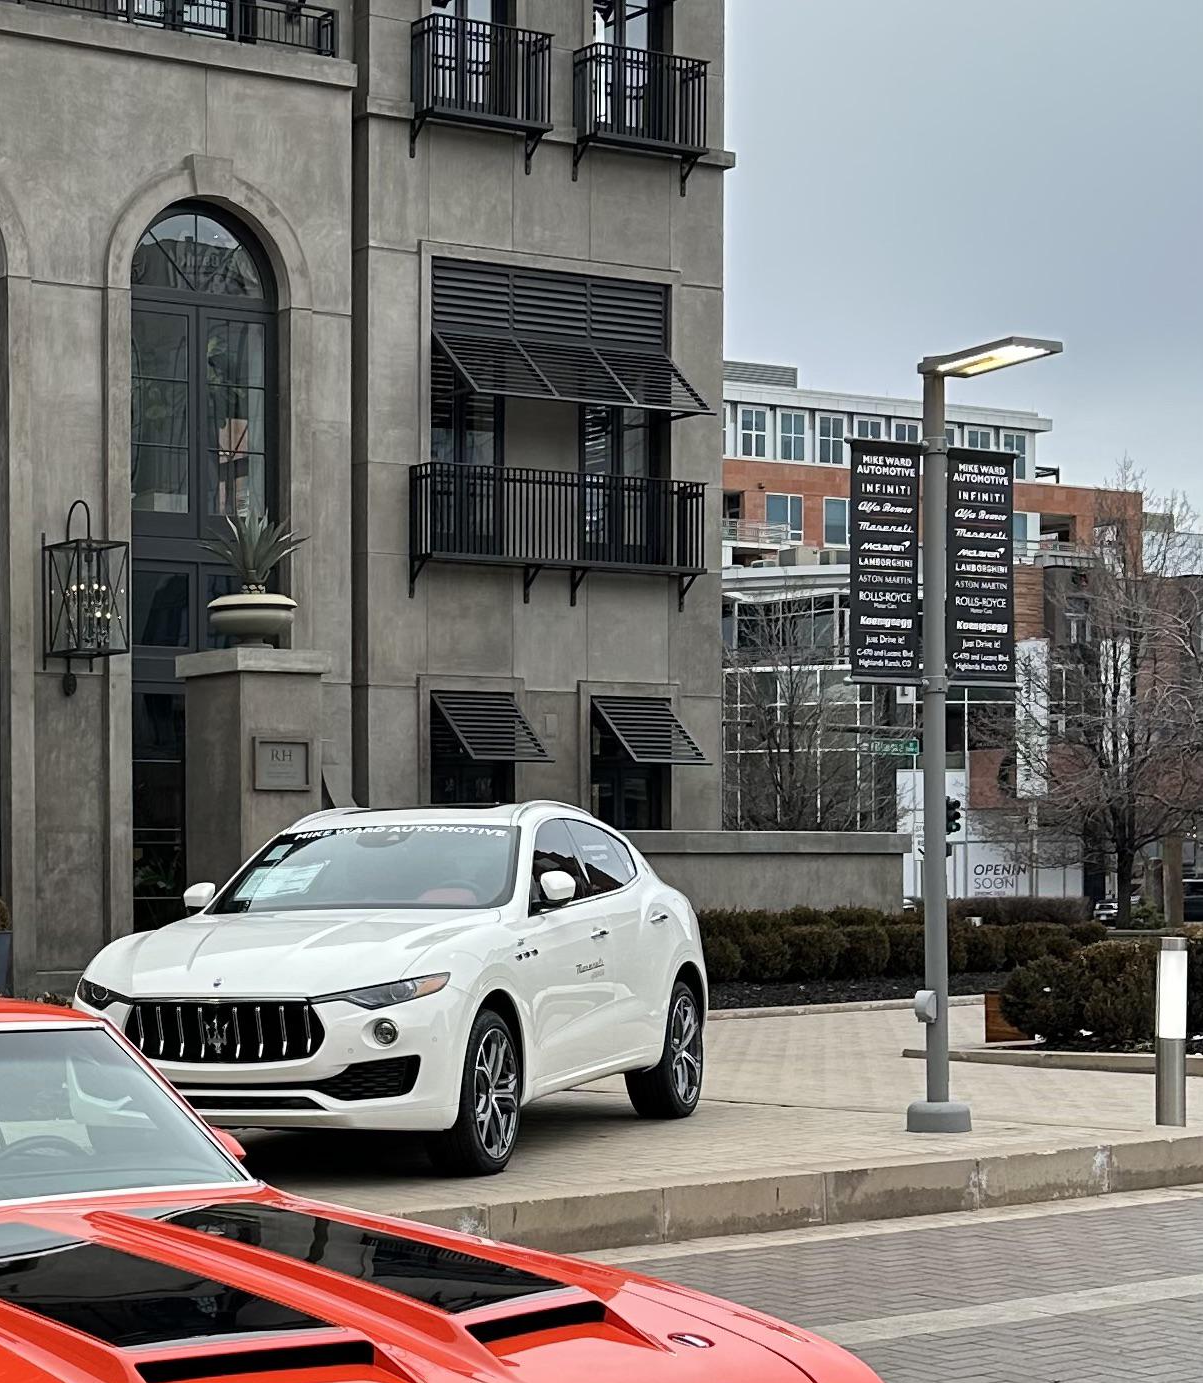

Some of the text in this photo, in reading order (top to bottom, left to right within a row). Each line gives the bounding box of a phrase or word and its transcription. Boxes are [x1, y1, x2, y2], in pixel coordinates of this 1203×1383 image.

[862, 455, 912, 467] MIKE WARD
[857, 465, 915, 477] AUTOMOTIVE
[958, 463, 1006, 475] MIKE WARD
[953, 473, 1009, 485] AUTOMOTIVE
[861, 483, 911, 495] INFINITI
[958, 490, 1005, 503] INFINITI
[858, 501, 913, 514] Alfa Romeo
[954, 508, 1008, 521] Alfa Romeo
[857, 521, 914, 533] Maserati
[954, 528, 1008, 540] Maserati
[860, 542, 906, 552] McLaren
[957, 548, 1001, 558] McLaren
[858, 557, 913, 567] LAMBORGHINI
[955, 563, 1008, 574] LAMBORGHINI
[858, 574, 913, 585] ASTON MARTIN
[955, 580, 1008, 590] ASTON MARTIN
[858, 591, 912, 602] ROLLS-ROYCE
[955, 597, 1007, 608] ROLLS-ROYCE
[271, 749, 293, 761] RH
[294, 825, 508, 840] MIKE WARD AUTOMOTIVE
[974, 864, 1027, 876] OPENIN
[974, 877, 1014, 889] SOON
